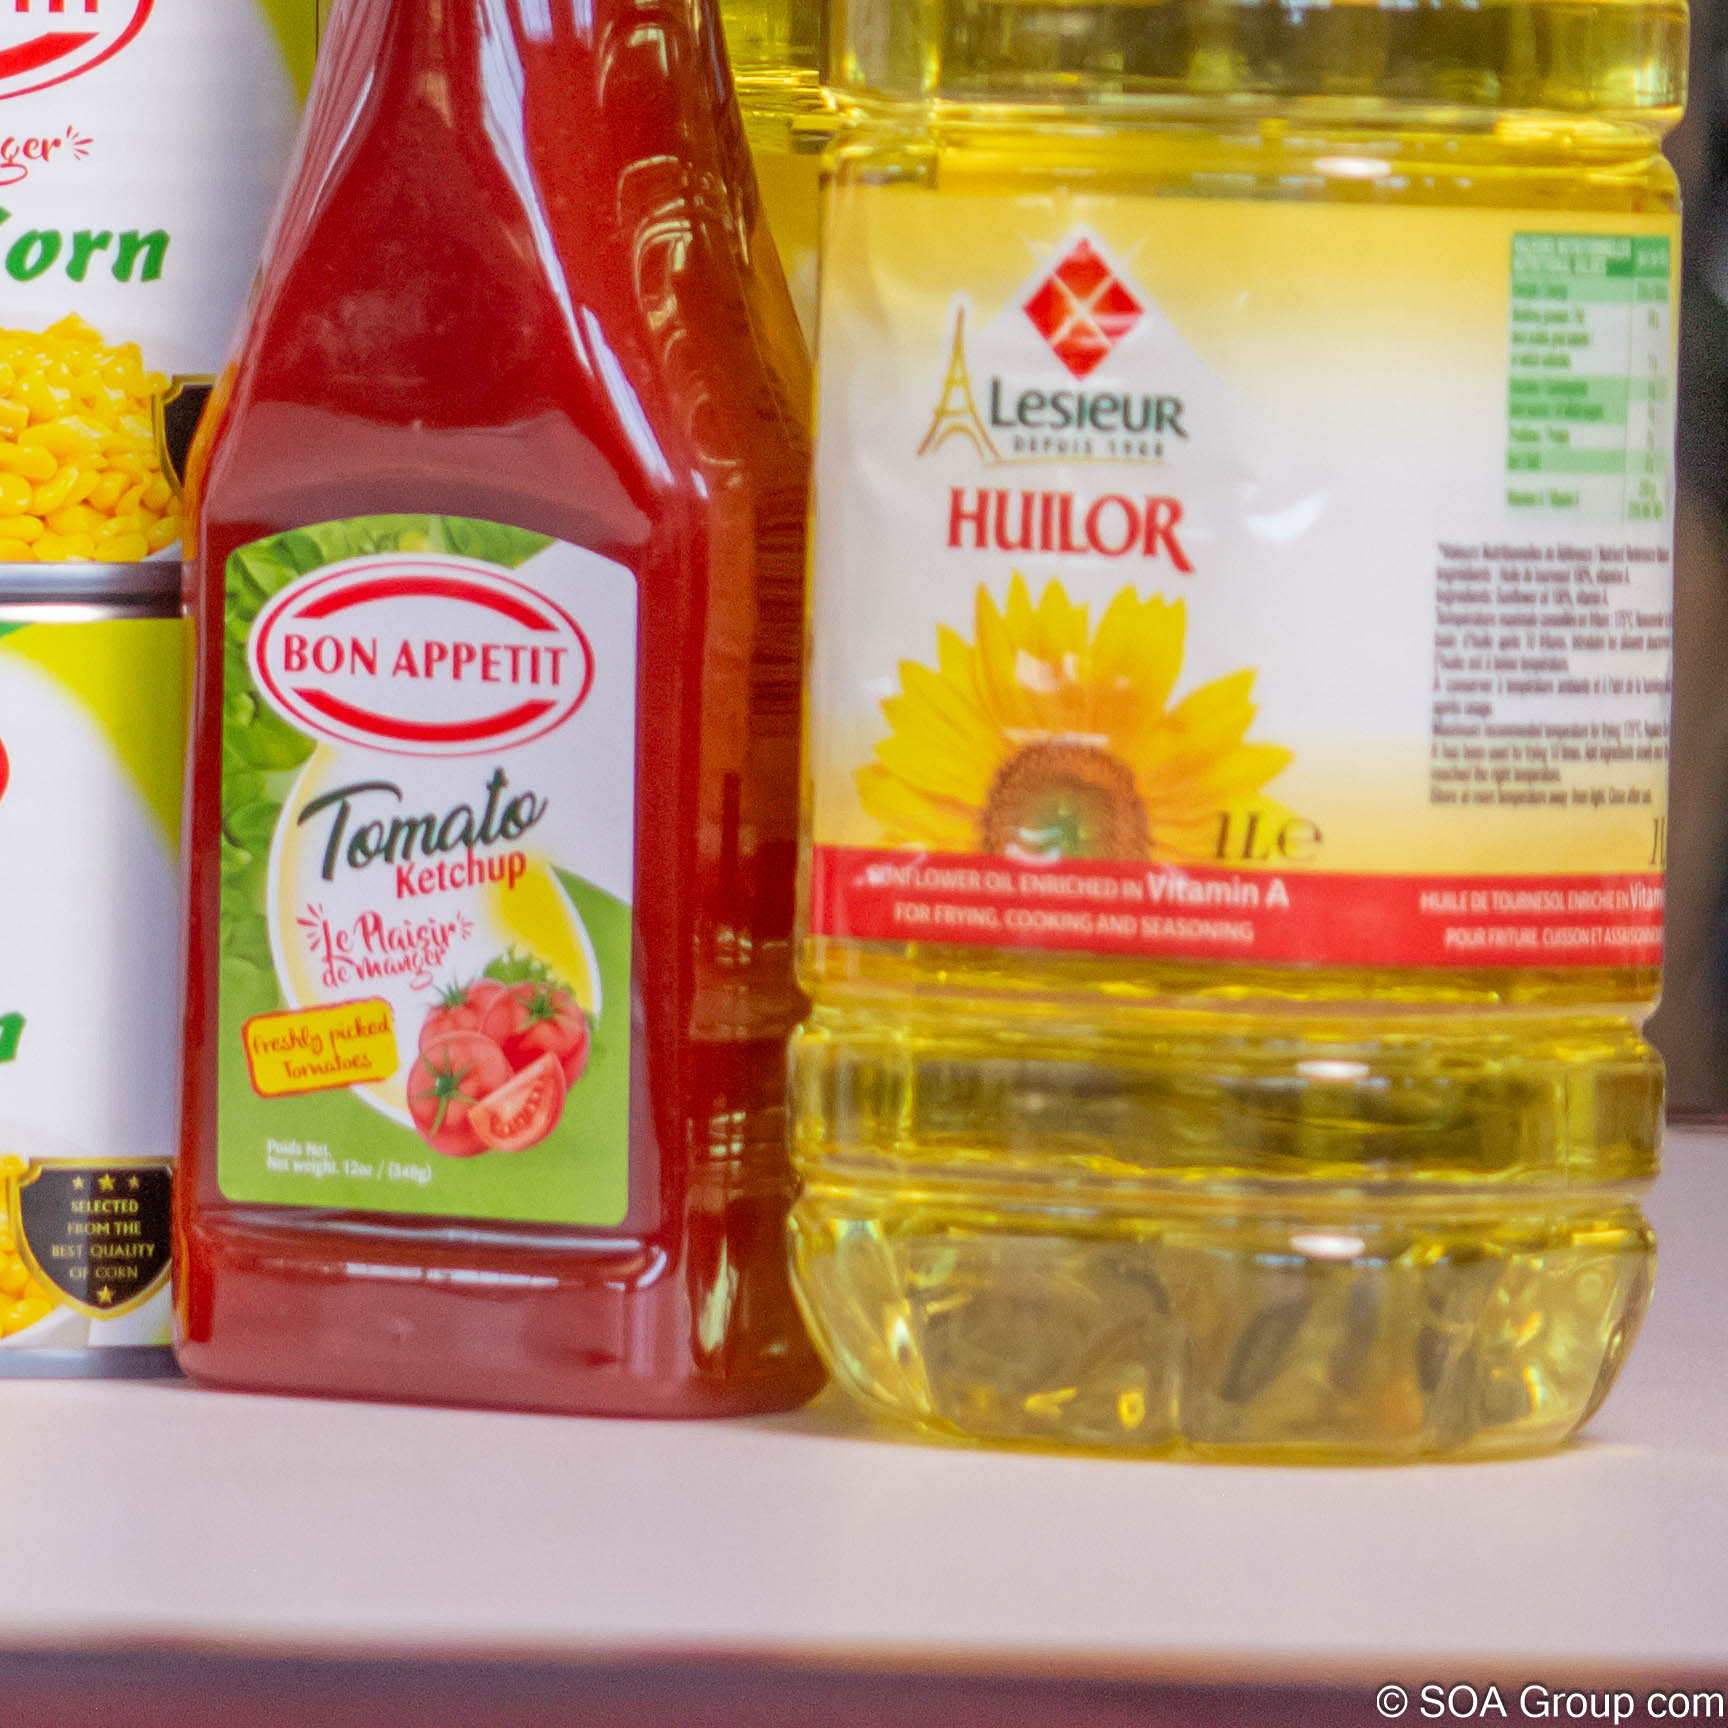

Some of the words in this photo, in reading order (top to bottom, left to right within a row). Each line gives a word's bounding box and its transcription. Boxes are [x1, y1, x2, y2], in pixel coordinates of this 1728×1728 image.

[947, 485, 1196, 575] HUILOR
[282, 633, 381, 677] BON
[392, 640, 569, 687] APPETIT
[297, 767, 550, 882] Tomato
[395, 849, 527, 900] Ketchup
[1020, 873, 1119, 900] ENRICHED
[1123, 878, 1144, 902] IN
[1147, 869, 1260, 907] Vitamin
[1265, 876, 1290, 910] A
[354, 910, 457, 954] Plaisir
[893, 902, 931, 925] FOR
[1097, 912, 1138, 938] AND
[71, 1199, 140, 1213] SELECTED
